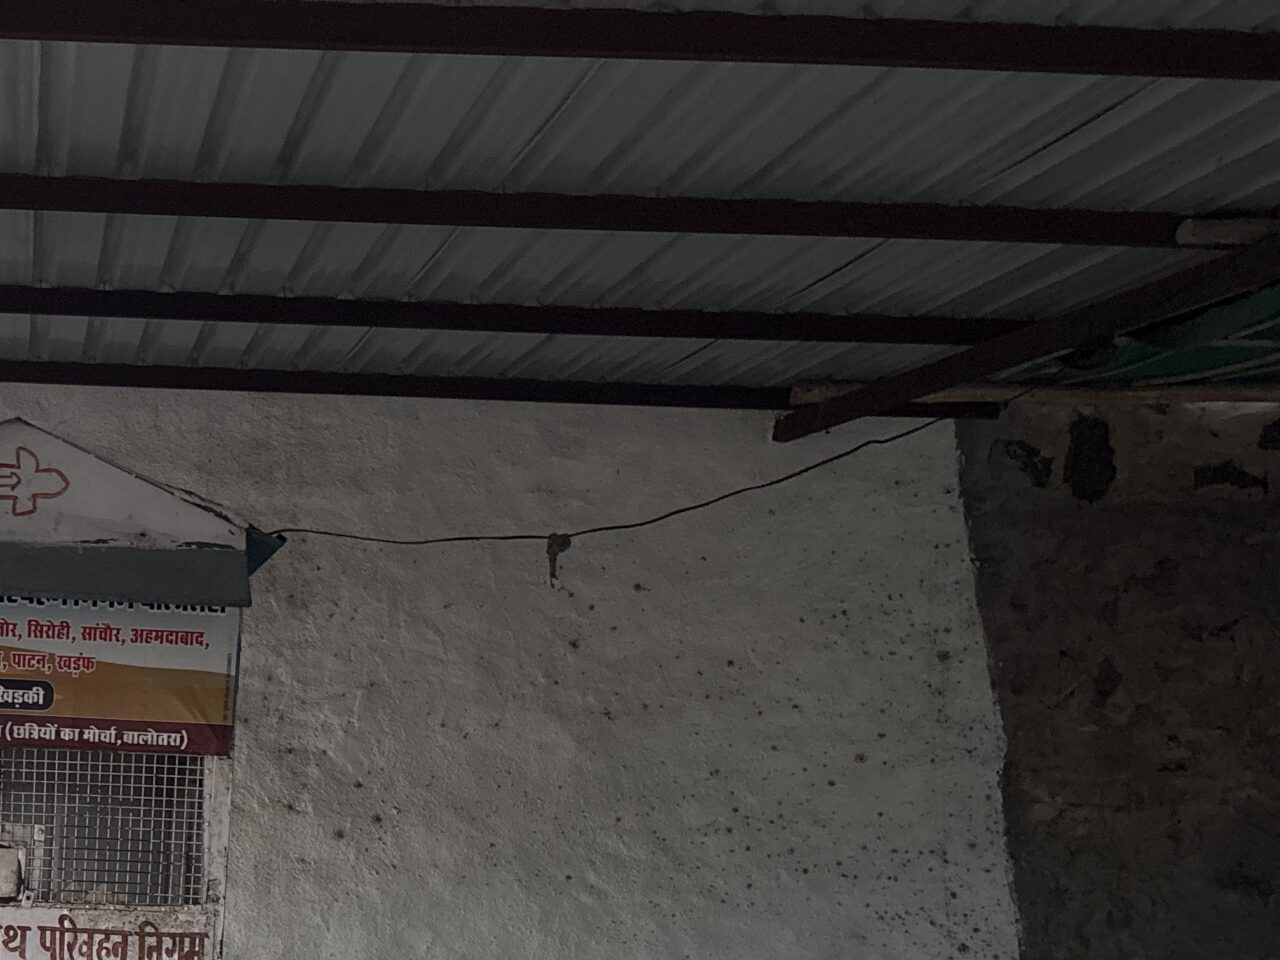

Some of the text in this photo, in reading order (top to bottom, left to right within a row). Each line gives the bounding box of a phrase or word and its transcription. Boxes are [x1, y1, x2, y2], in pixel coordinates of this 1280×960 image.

[28, 620, 76, 643] सिरोही,
[81, 623, 125, 646] सांचौर,
[131, 628, 210, 649] अहमदाबाद,
[12, 653, 52, 673] पाटन,
[60, 725, 79, 741] का
